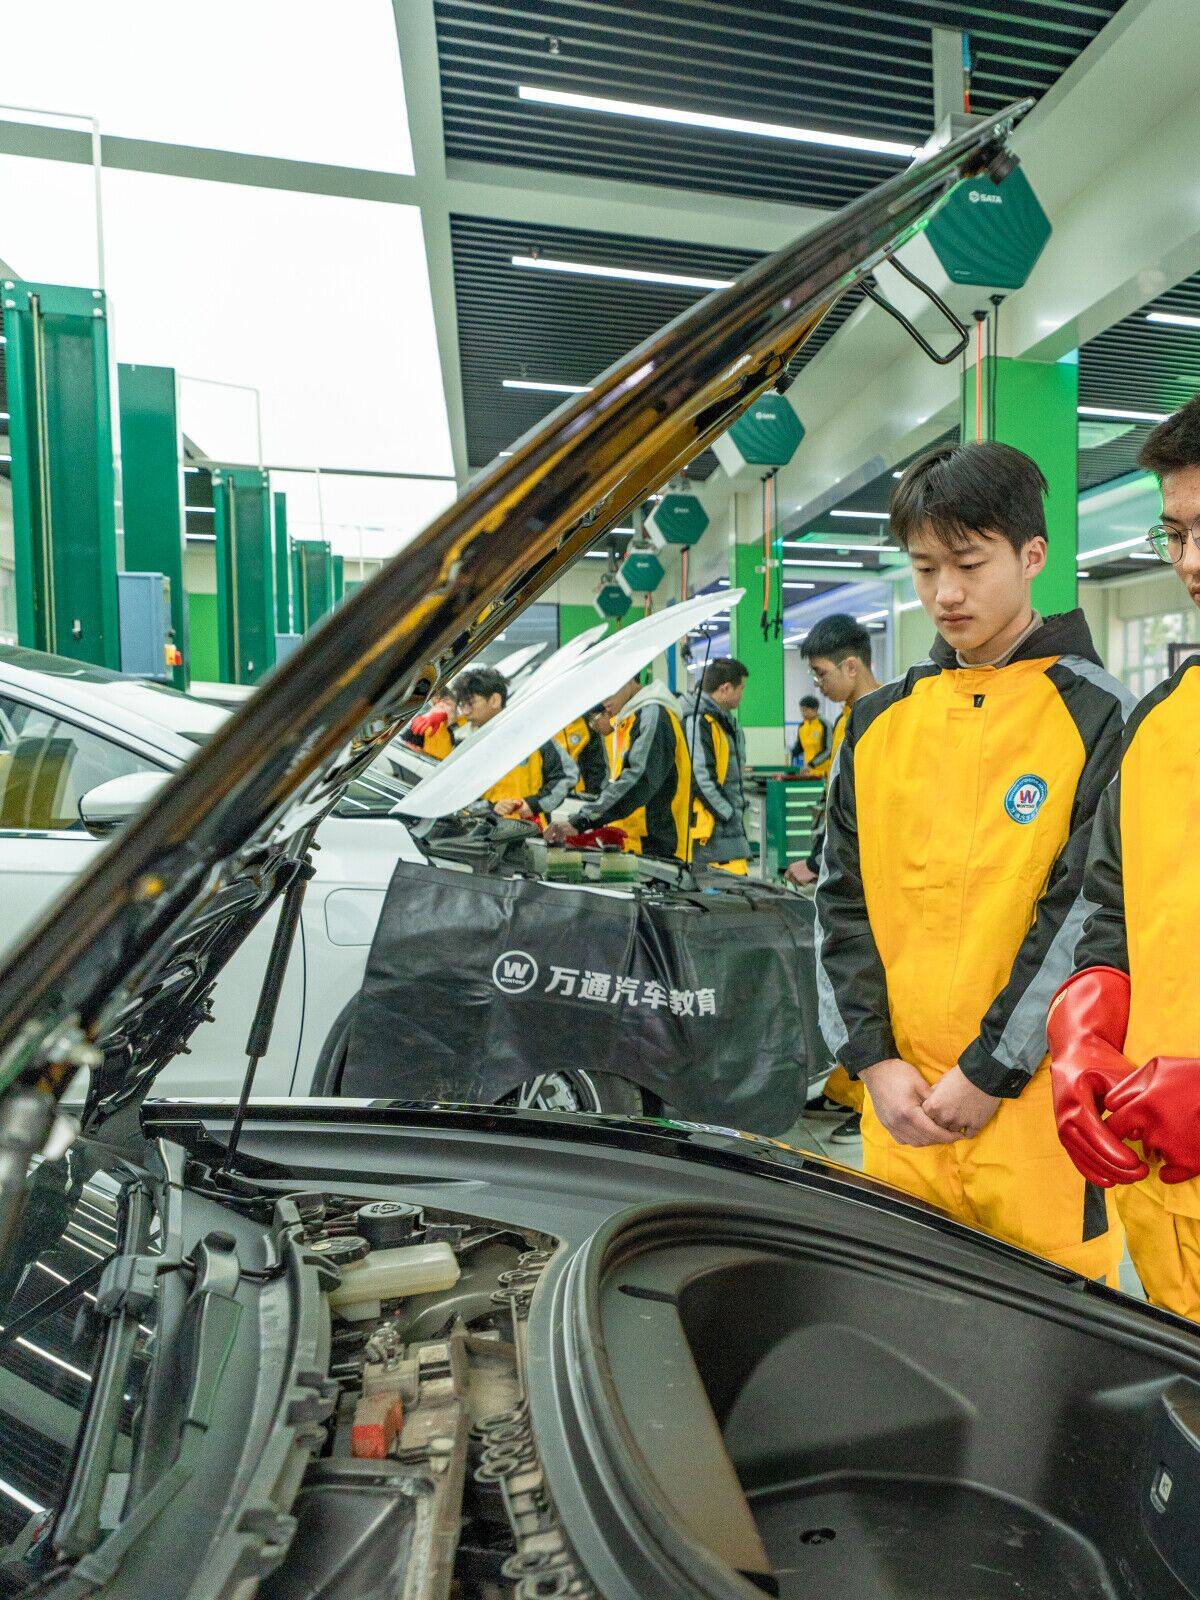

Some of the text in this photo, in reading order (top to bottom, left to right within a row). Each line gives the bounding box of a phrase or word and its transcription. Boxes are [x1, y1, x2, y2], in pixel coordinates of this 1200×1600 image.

[980, 193, 1003, 204] SATA
[503, 960, 530, 979] W
[545, 965, 716, 1017] 万通汽车教育
